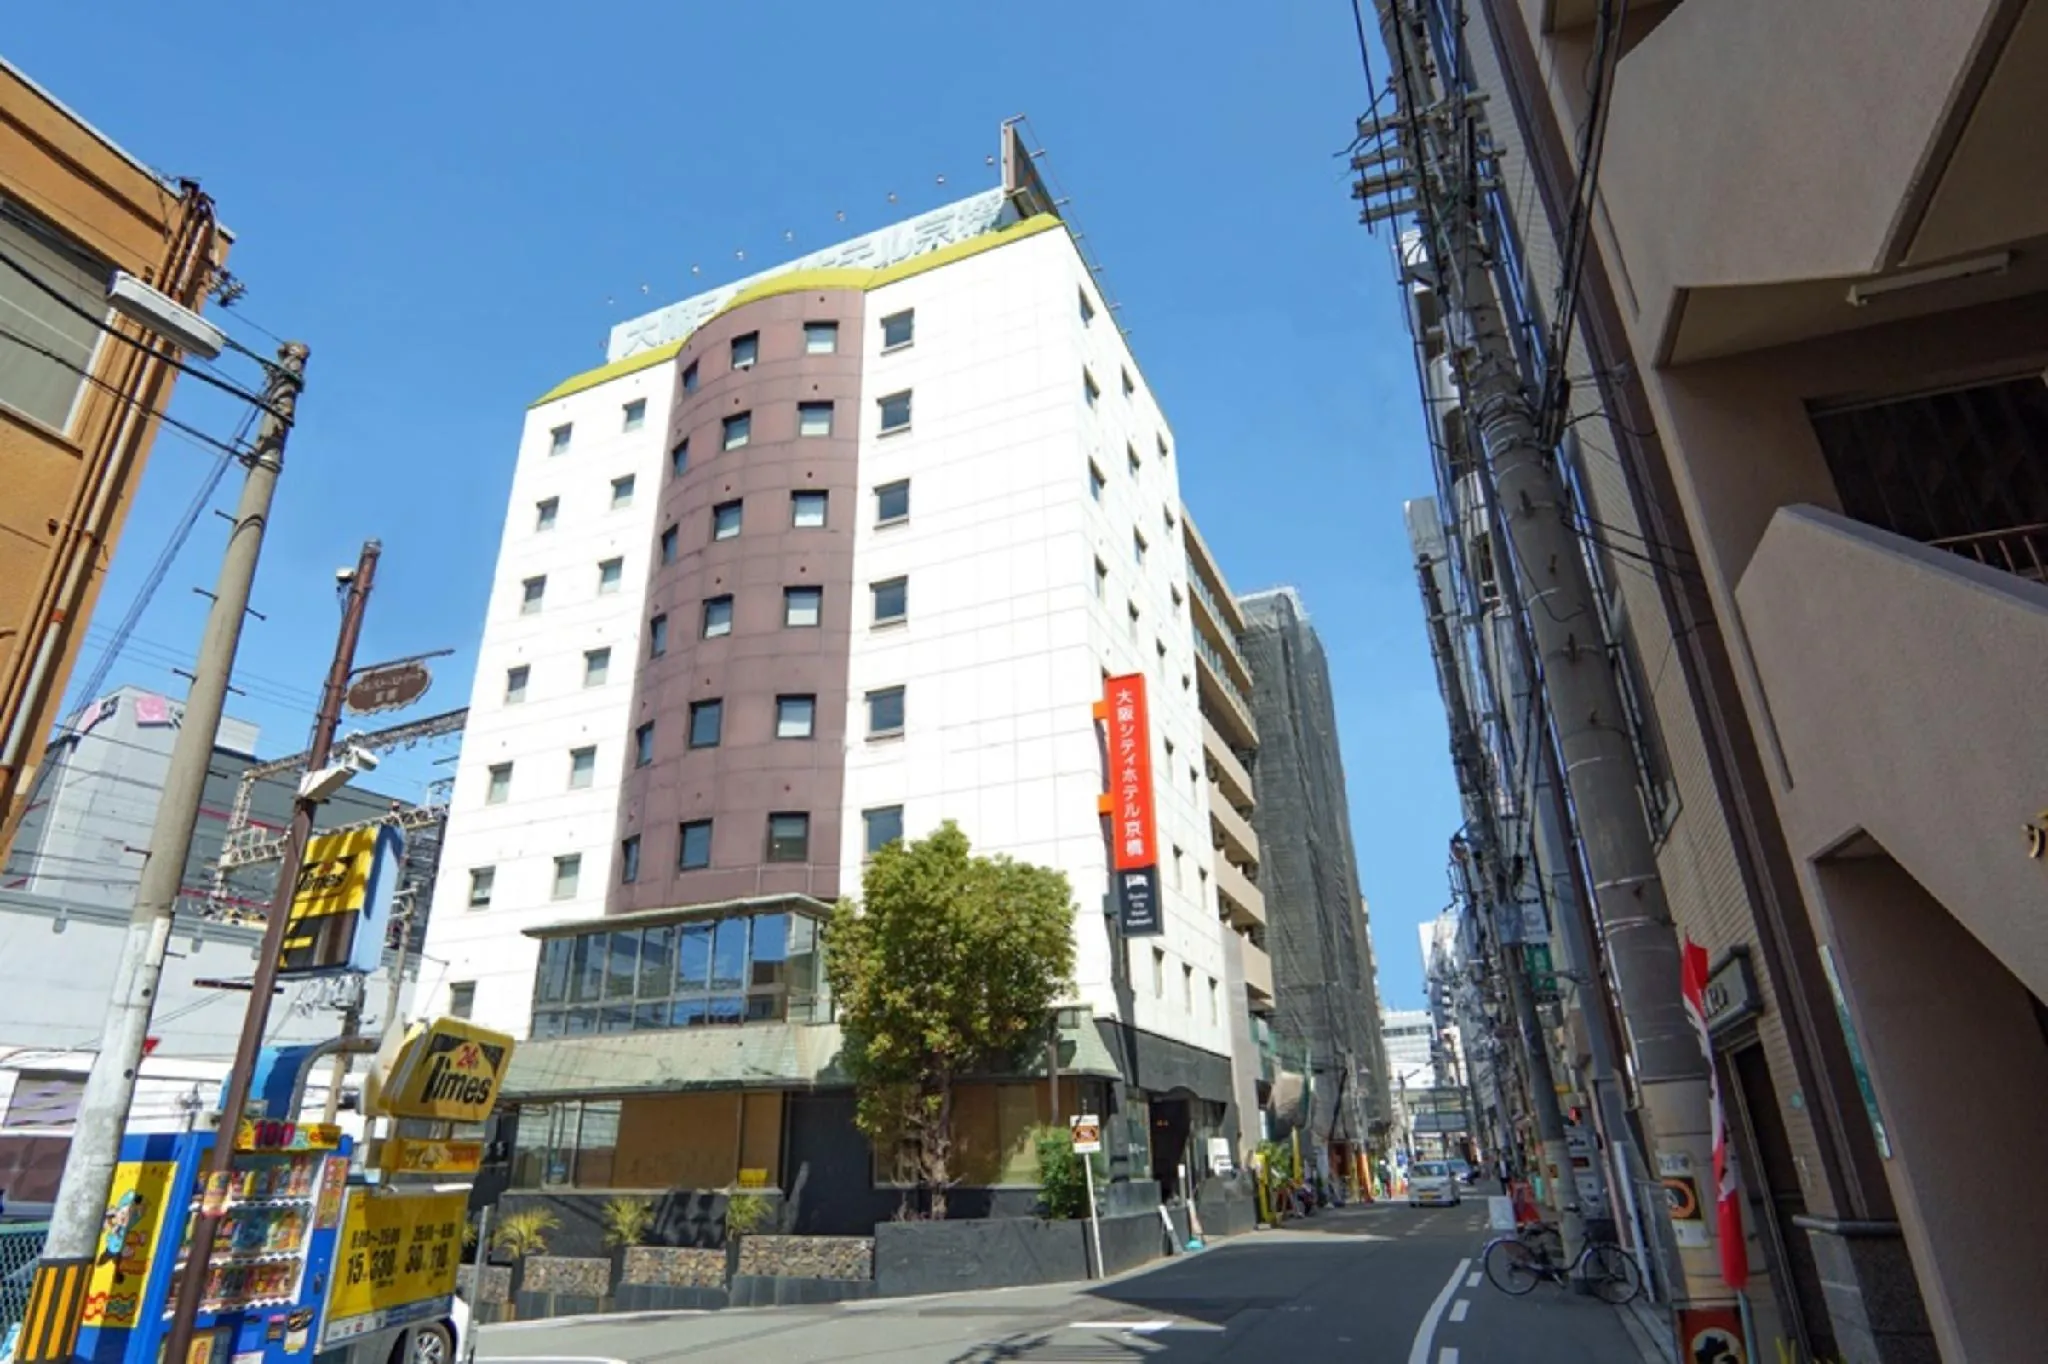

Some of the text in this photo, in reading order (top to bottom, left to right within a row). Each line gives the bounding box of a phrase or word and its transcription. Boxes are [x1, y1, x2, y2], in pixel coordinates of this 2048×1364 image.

[1115, 688, 1144, 857] 大阪シティホテル京橋
[420, 1054, 493, 1105] Times
